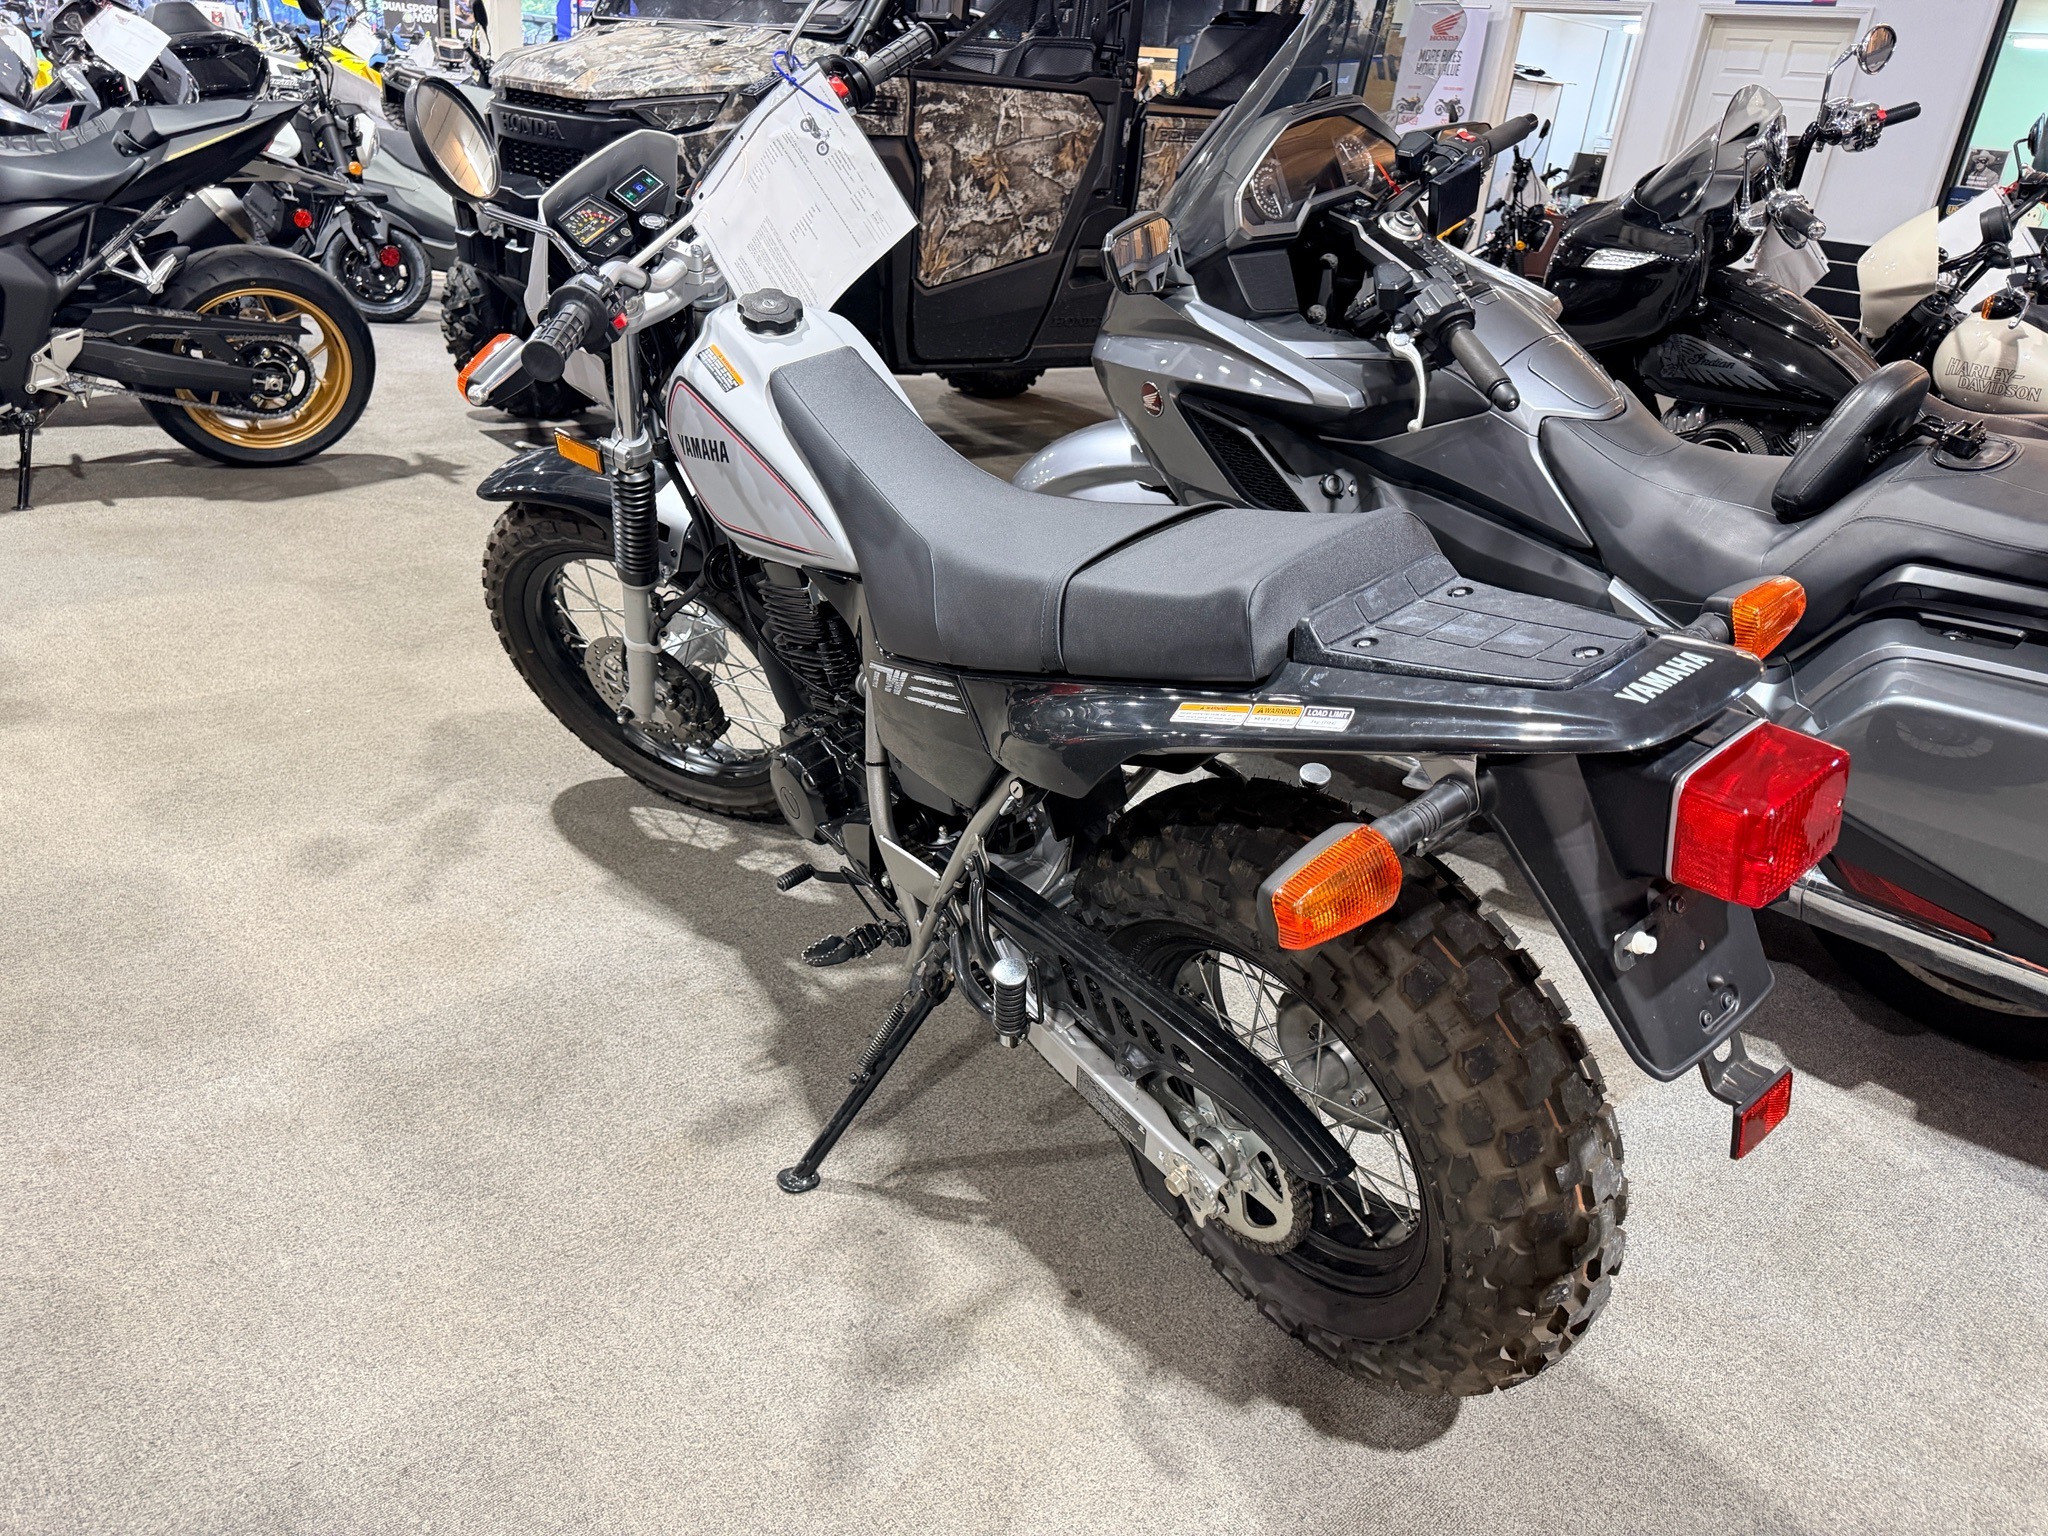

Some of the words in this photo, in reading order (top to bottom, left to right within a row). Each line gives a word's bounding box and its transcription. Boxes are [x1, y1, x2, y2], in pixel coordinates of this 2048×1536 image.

[383, 1, 438, 14] DUALSPORT
[1418, 49, 1441, 62] MORE
[1441, 50, 1463, 62] BIKES
[500, 112, 565, 139] HONDA
[1687, 353, 1736, 369] Indian
[1945, 357, 2026, 383] HARLEY-
[1957, 375, 2042, 402] DAVIDSON
[677, 433, 730, 463] YAMAHA
[1614, 651, 1714, 704] YAMAHA
[1264, 707, 1297, 715] WARNING
[1307, 709, 1328, 717] LOAD
[1329, 710, 1350, 719] LIMIT
